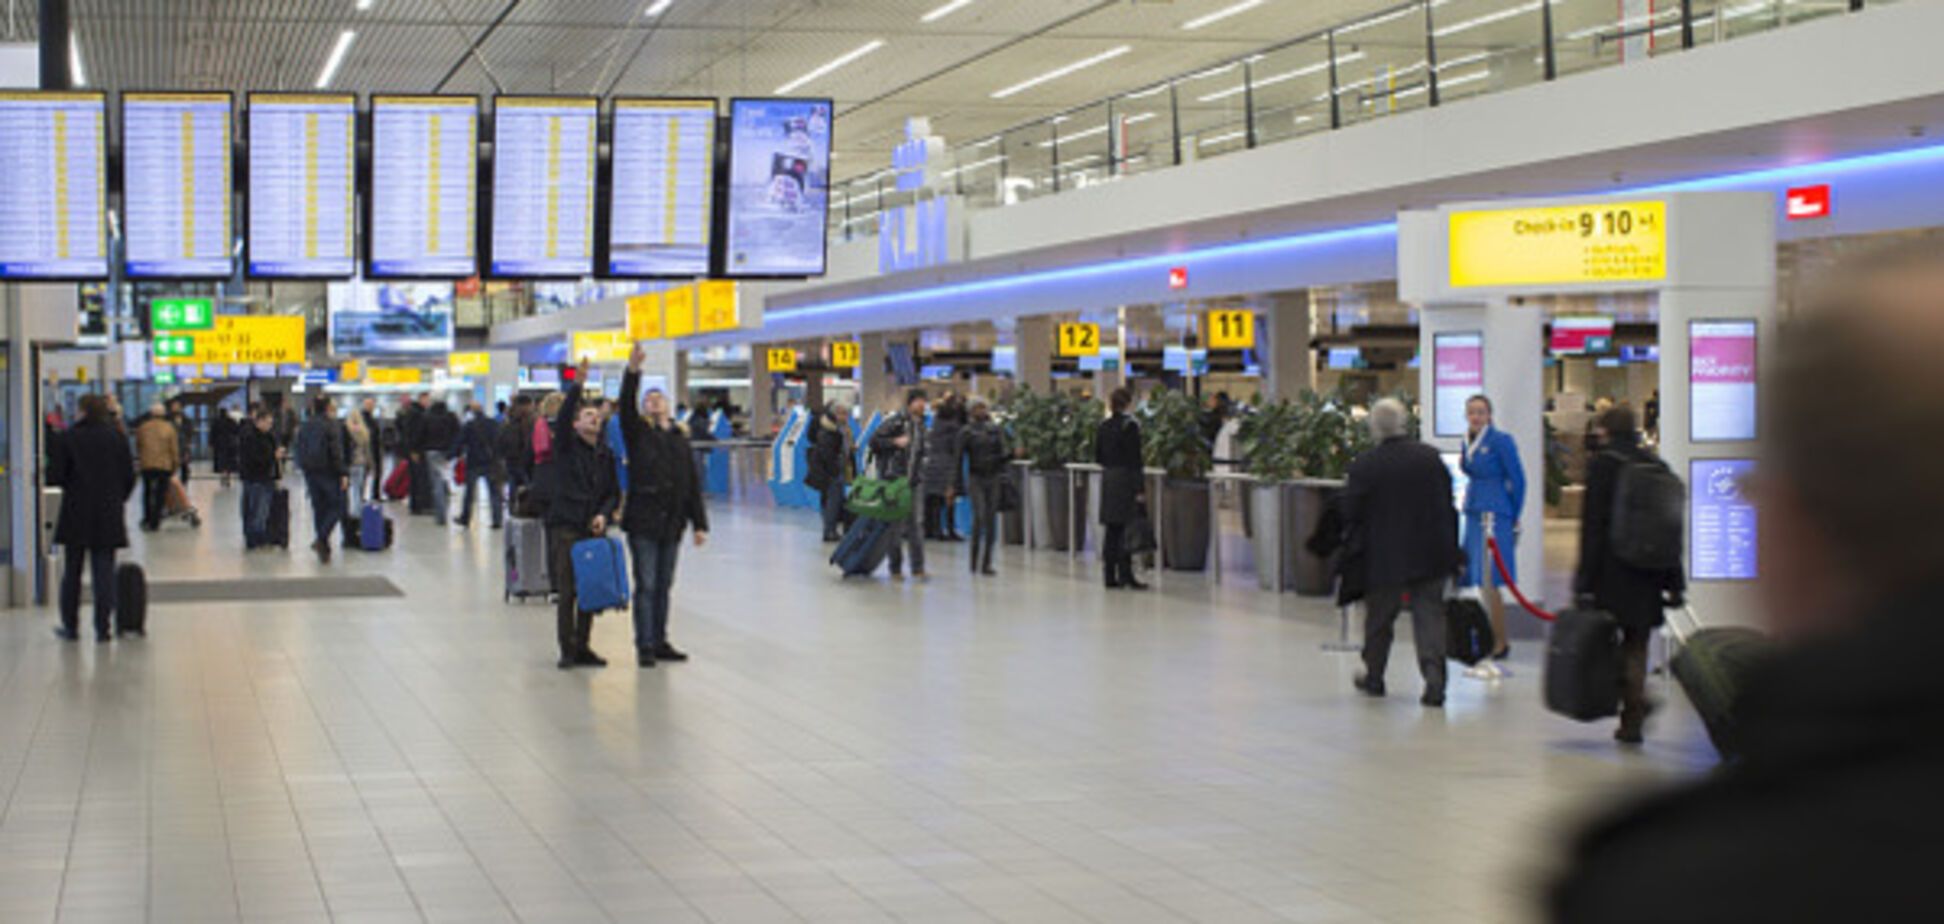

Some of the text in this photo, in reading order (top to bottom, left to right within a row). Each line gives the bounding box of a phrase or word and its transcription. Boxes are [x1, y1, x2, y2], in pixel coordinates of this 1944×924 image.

[1580, 212, 1594, 237] 9
[1604, 210, 1633, 235] 10
[1065, 325, 1093, 348] 12
[1217, 314, 1244, 338] 11
[771, 349, 792, 368] 14
[838, 344, 858, 360] 13
